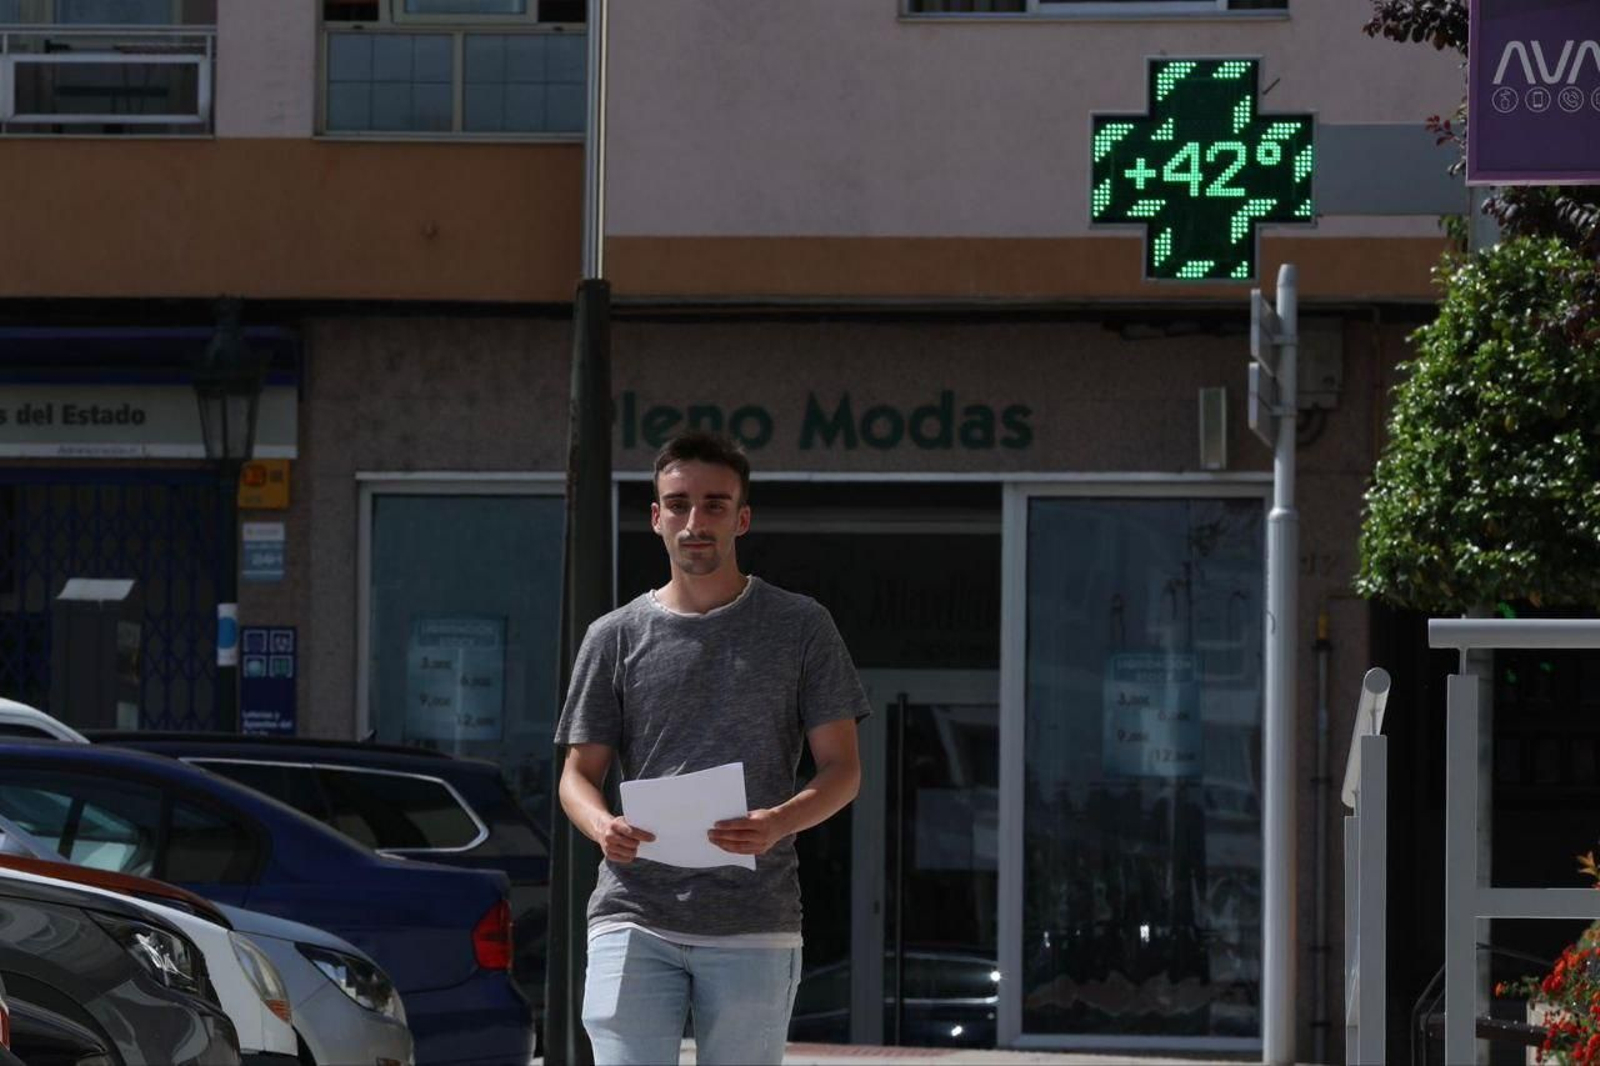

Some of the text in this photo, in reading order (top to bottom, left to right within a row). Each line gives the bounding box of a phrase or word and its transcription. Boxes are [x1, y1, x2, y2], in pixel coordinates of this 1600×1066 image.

[16, 403, 53, 425] del
[62, 403, 146, 426] Estado
[611, 391, 1034, 449] leno Modas
